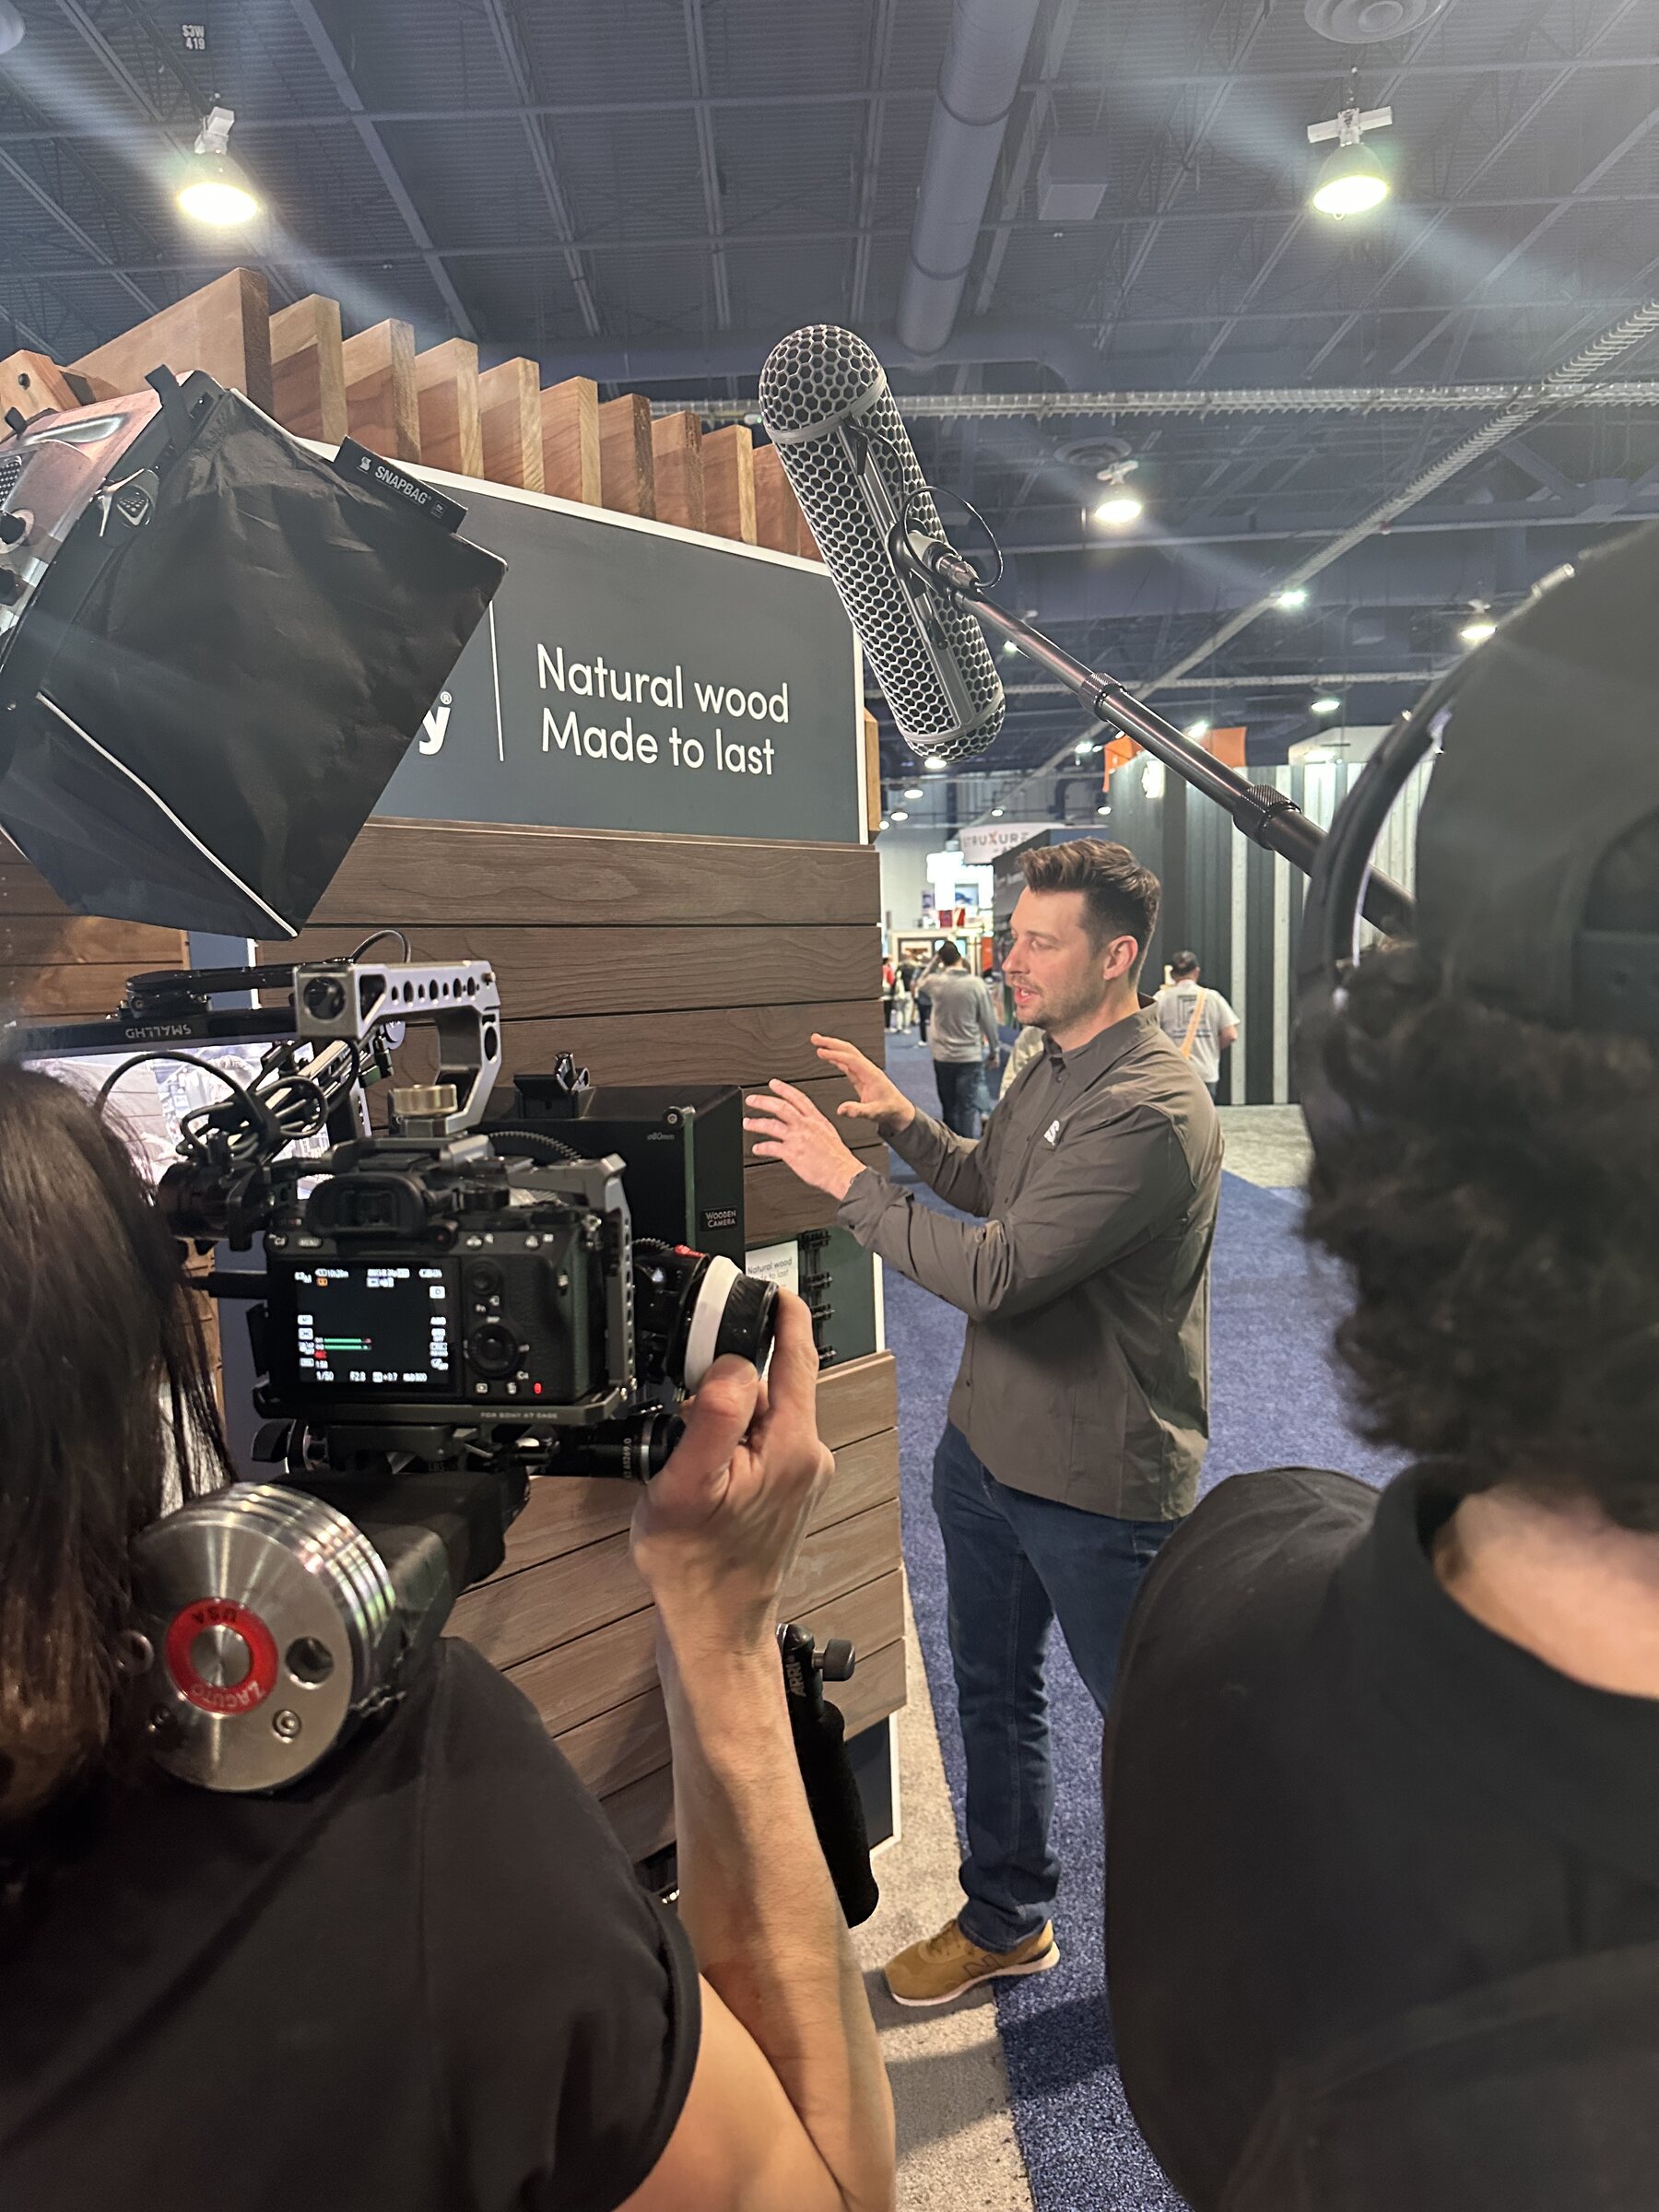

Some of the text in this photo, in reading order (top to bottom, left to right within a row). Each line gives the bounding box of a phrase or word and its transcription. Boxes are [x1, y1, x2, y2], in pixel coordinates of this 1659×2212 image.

[186, 37, 206, 50] 419
[537, 643, 790, 724] Natural wood
[542, 707, 775, 775] Made to last
[705, 1210, 736, 1220] WOODEN
[707, 1218, 735, 1228] CAMERA
[747, 1257, 793, 1274] Natural wood
